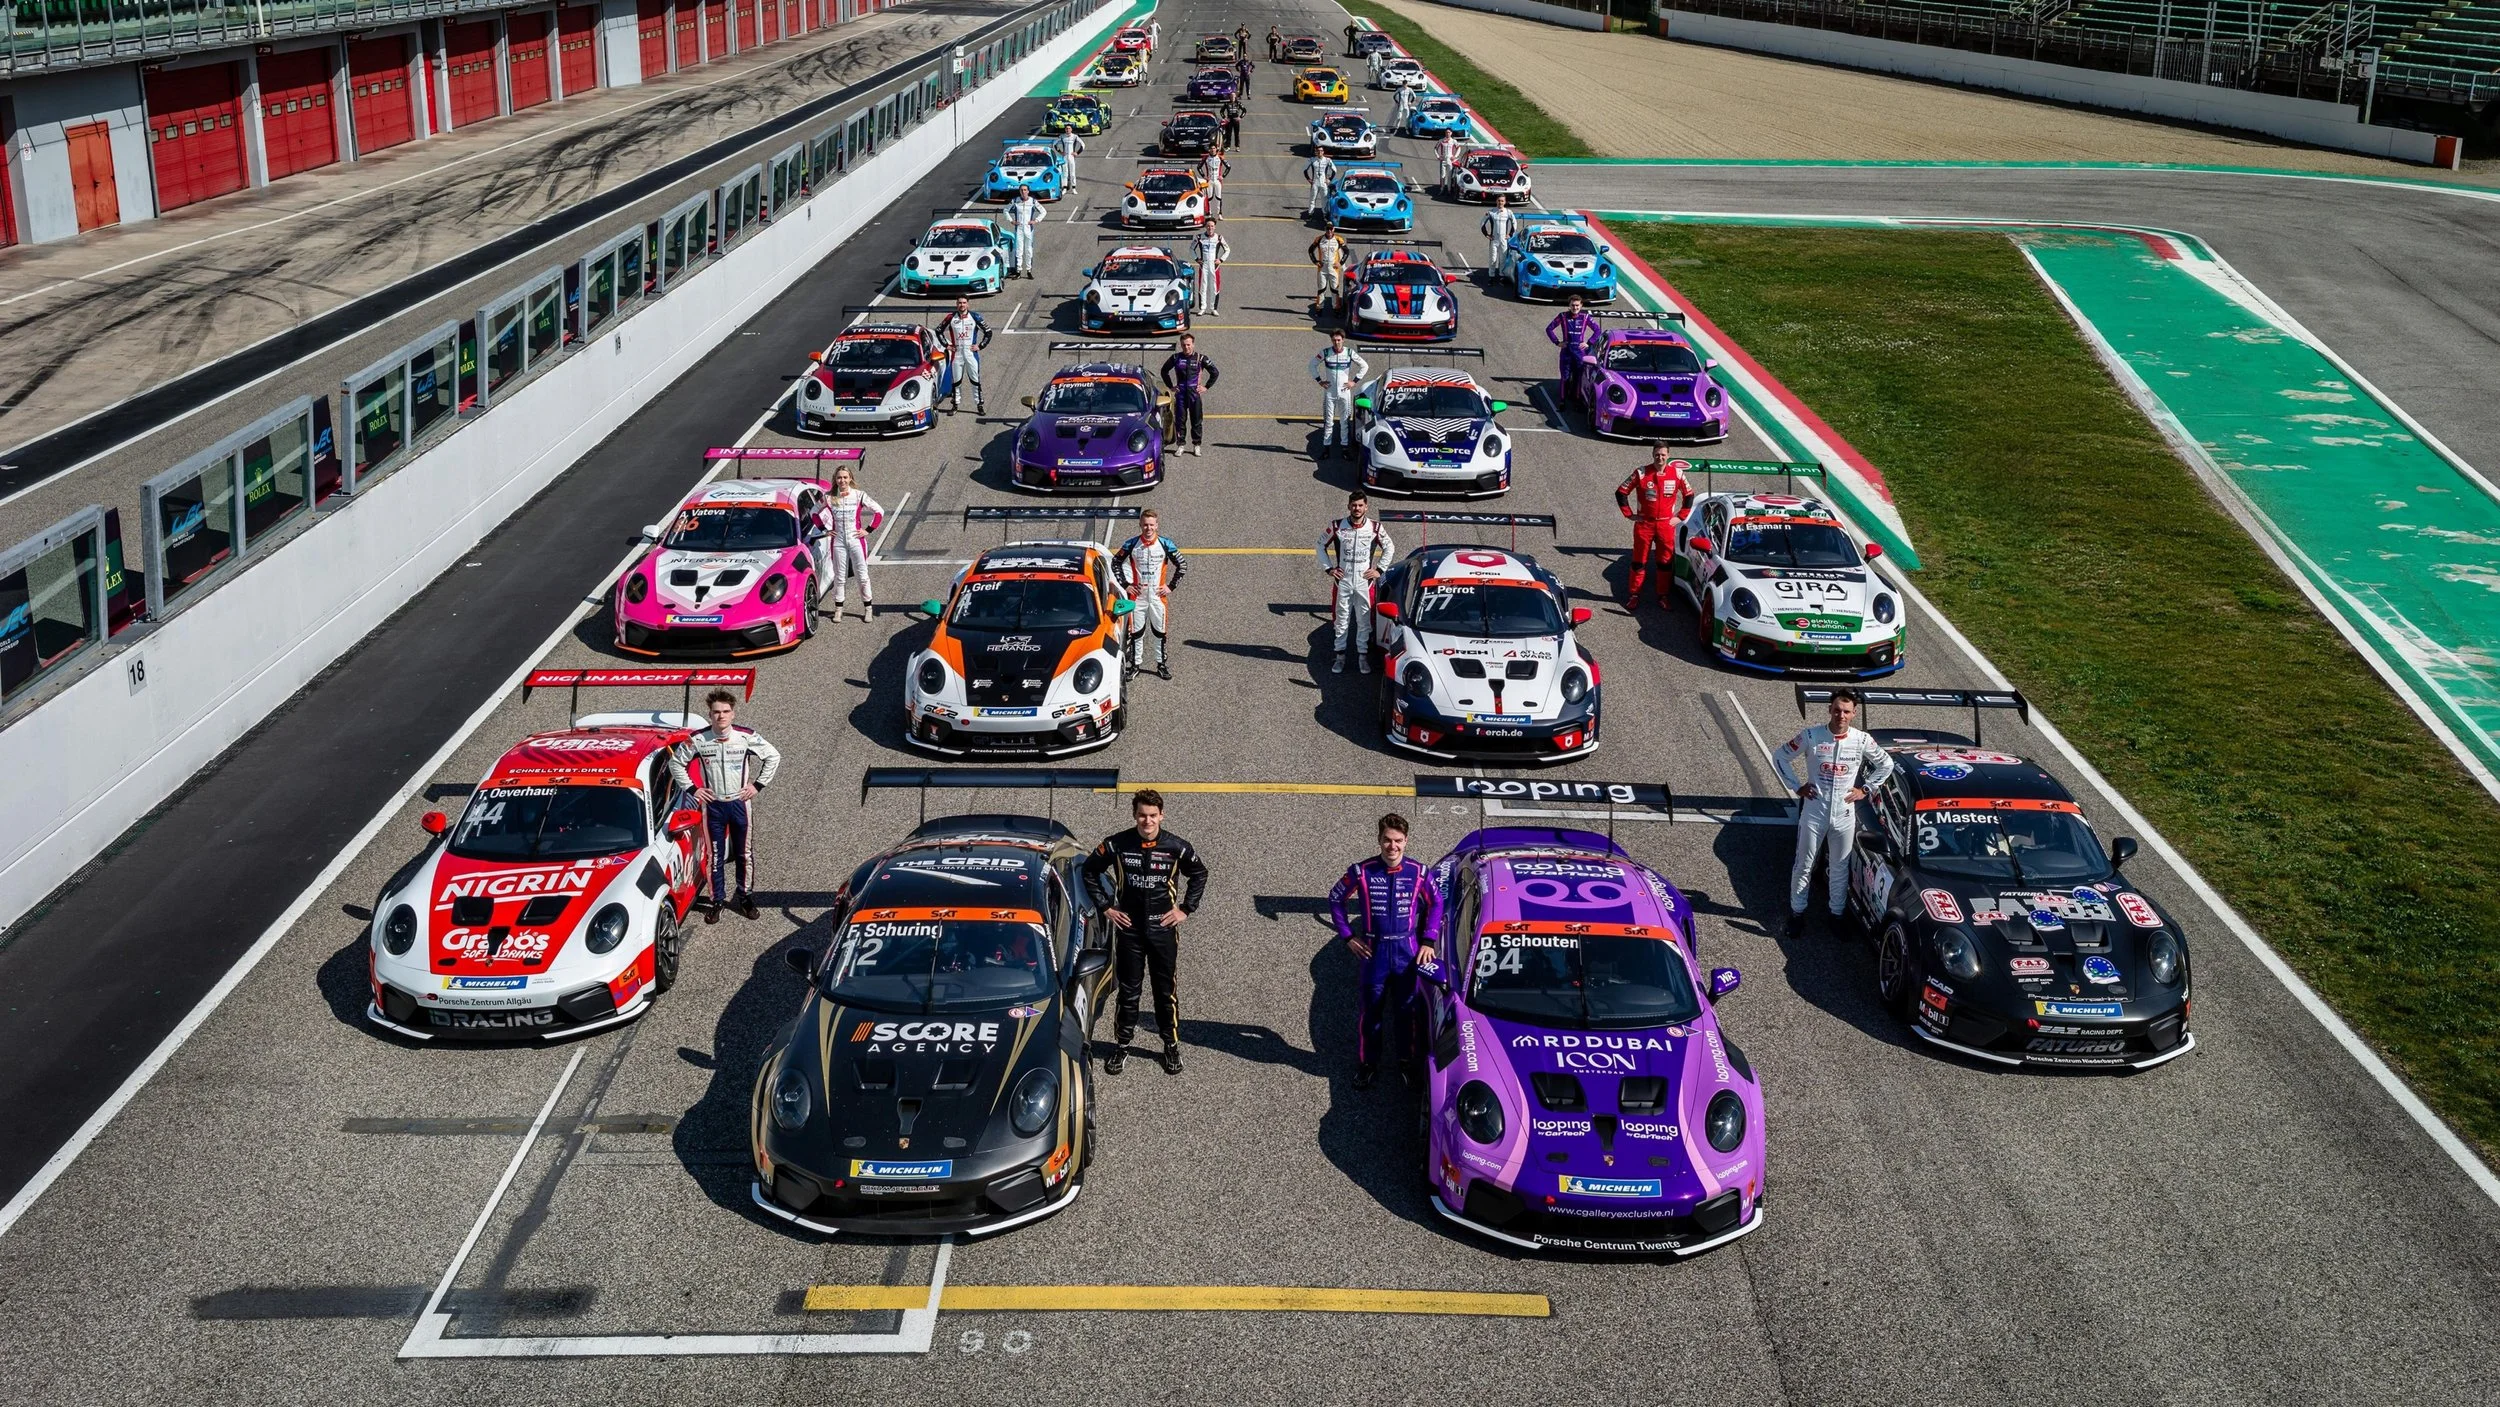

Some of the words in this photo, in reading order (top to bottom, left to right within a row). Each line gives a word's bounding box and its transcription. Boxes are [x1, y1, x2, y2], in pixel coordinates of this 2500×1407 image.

[369, 414, 388, 432] ROLEX
[1694, 462, 1747, 471] eektro
[1752, 464, 1820, 473] essann
[249, 482, 271, 503] ROLEX
[692, 508, 726, 516] Vateva
[106, 570, 123, 591] LEX
[972, 582, 1002, 592] Greif
[1775, 581, 1846, 594] GIRA
[1438, 585, 1475, 594] Perrot
[1423, 594, 1453, 611] 77
[986, 644, 1042, 652] HERANDO
[130, 659, 145, 685] 18
[609, 674, 683, 682] MACHT
[1803, 690, 2017, 704] PRSCE
[1476, 727, 1523, 737] foerch.de
[498, 778, 521, 786] SIXT
[548, 776, 572, 784] SIXT
[600, 778, 624, 786] SIXT
[490, 786, 558, 799] Oeverhaus
[1455, 777, 1636, 803] looping
[1937, 800, 1960, 808] SIXT
[1989, 800, 2013, 808] SIXT
[2040, 802, 2061, 811] SIXT
[465, 801, 506, 826] 44
[1916, 813, 1932, 825] K.
[1935, 811, 2001, 825] Masters
[1918, 827, 1940, 851] 3
[896, 860, 941, 868] THE
[941, 857, 1025, 867] GRID
[1504, 862, 1626, 877] looping
[1530, 870, 1614, 879] CarTech
[439, 870, 593, 902] NIGRIN
[872, 910, 898, 919] SIXT
[931, 909, 957, 918] SIXT
[990, 910, 1017, 919] SIXT
[864, 922, 943, 938] Schuring
[1503, 922, 1531, 931] SIXT
[1564, 924, 1591, 933] SIXT
[1624, 926, 1649, 936] SIXT
[1480, 936, 1496, 950] D.
[1500, 934, 1579, 949] Schouten
[461, 950, 490, 959] SOFT
[500, 949, 543, 959] DRINKS
[840, 938, 884, 966] 12
[465, 978, 520, 988] MICHELIN
[438, 997, 469, 1005] Porsche
[470, 998, 505, 1006] Zentrum
[506, 997, 532, 1007] Allgäu
[2027, 993, 2067, 1001] Proton
[1918, 1001, 1939, 1020] Mobil
[452, 1008, 554, 1028] RACING
[870, 1022, 999, 1042] SCORE
[867, 1043, 996, 1053] AGENCY
[1461, 1020, 1478, 1072] looping.com
[1543, 1036, 1580, 1047] RD
[1585, 1036, 1673, 1052] DUBAI
[2025, 1038, 2126, 1053] FATURBO
[1556, 1051, 1637, 1071] ICON
[1715, 1030, 1730, 1083] looping.com
[2026, 1055, 2053, 1063] Porsche
[1532, 1118, 1591, 1133] looping
[1620, 1119, 1679, 1137] looping
[1634, 1131, 1674, 1141] CarTech
[1462, 1150, 1502, 1171] looping.com
[878, 1165, 943, 1174] MICHELIN
[1716, 1160, 1748, 1180] looping.com
[1588, 1182, 1653, 1193] MICHELIN
[1548, 1205, 1674, 1218] www.cgalleryexclusive.nl
[1533, 1233, 1582, 1247] Porsche
[1584, 1237, 1636, 1251] Centrum
[1637, 1239, 1681, 1251] Twente
